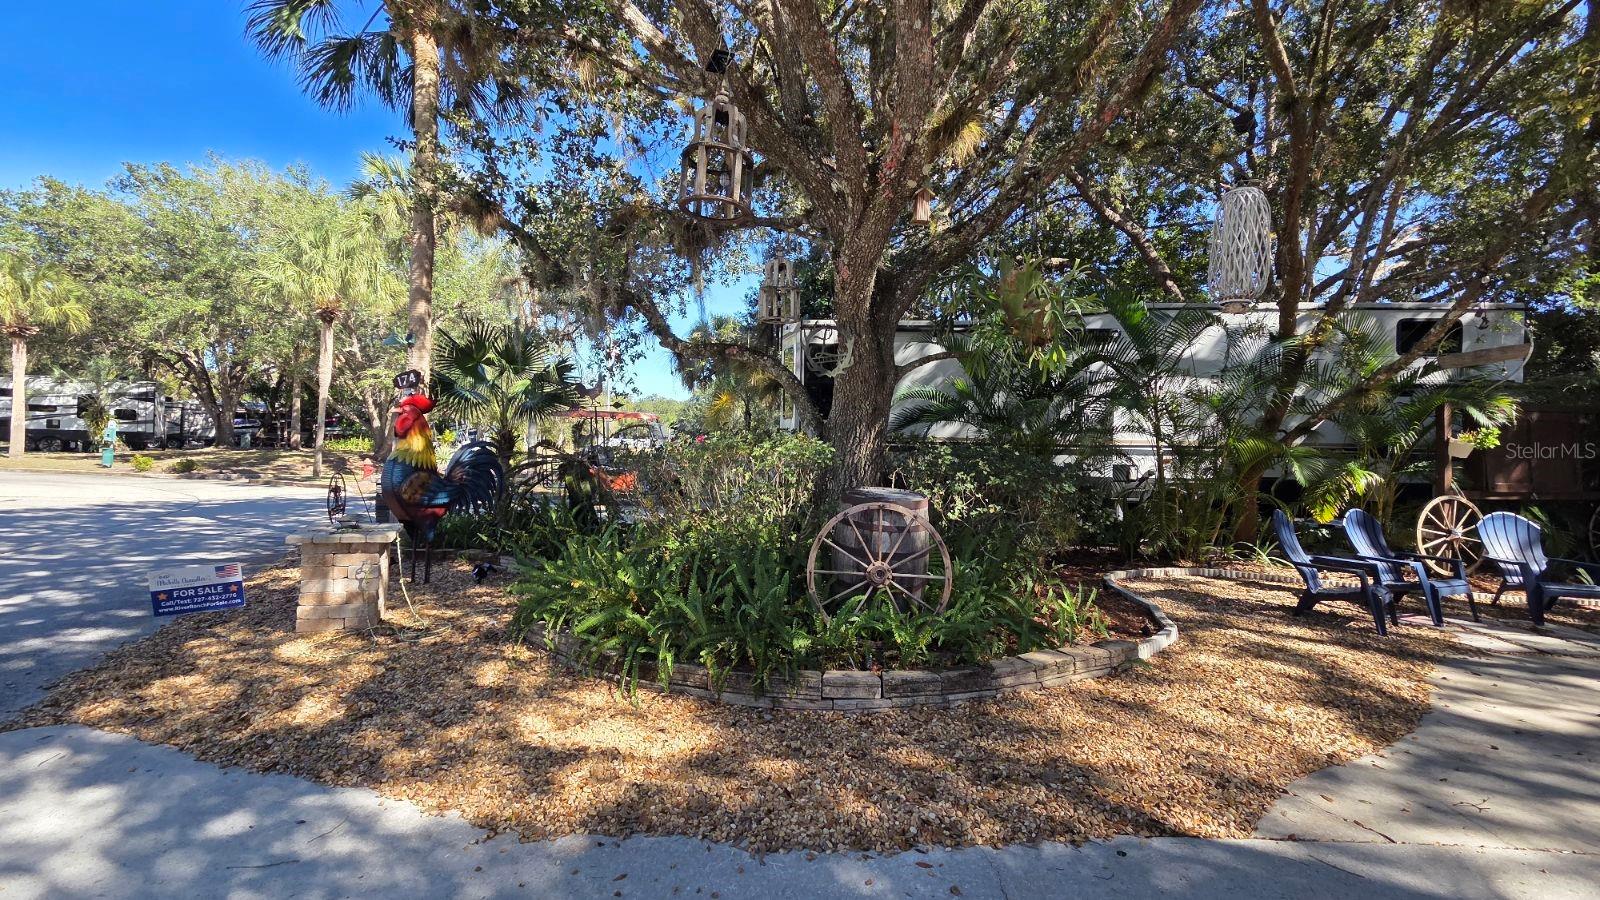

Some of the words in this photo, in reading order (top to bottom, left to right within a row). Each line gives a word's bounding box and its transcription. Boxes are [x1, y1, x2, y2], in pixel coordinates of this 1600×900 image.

[397, 372, 416, 386] 174
[173, 589, 195, 597] FOR
[197, 586, 223, 595] SALE
[161, 598, 192, 607] Call/Text:
